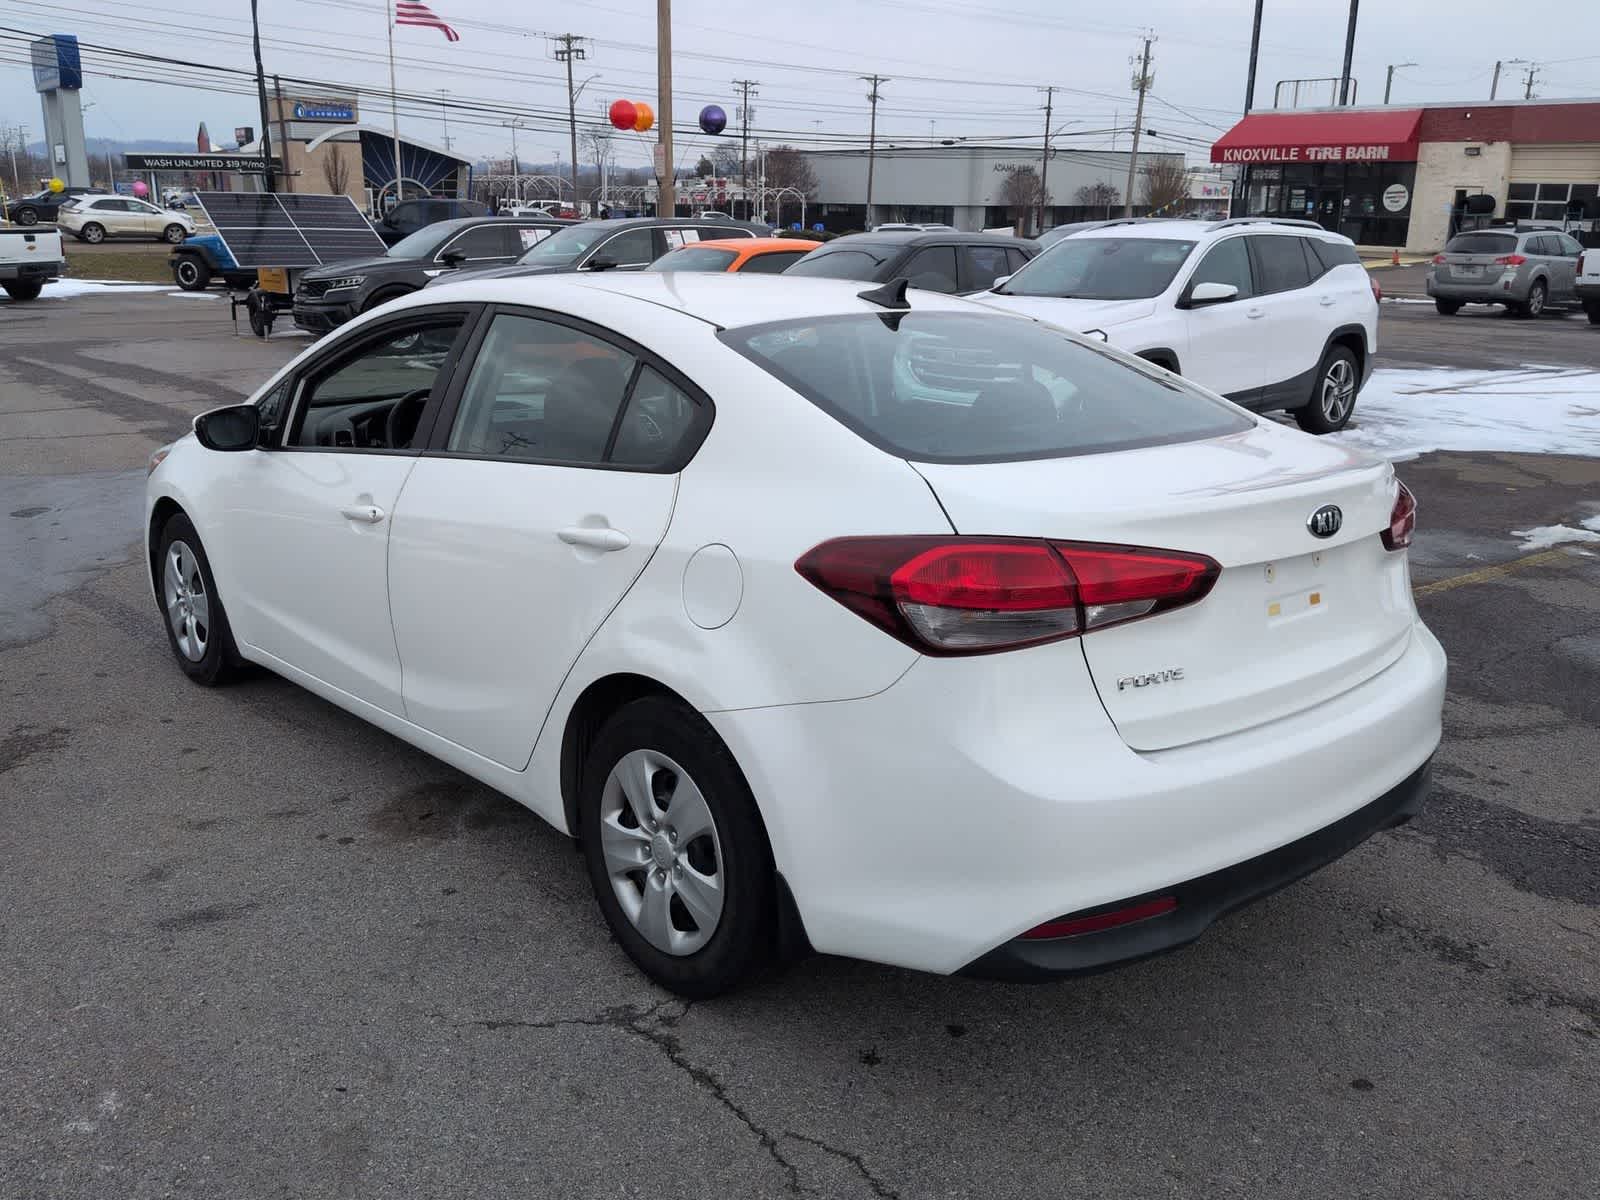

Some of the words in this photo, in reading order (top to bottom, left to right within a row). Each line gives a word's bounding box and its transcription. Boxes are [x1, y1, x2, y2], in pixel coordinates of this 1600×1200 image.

[1223, 147, 1299, 161] KNOXVILLE
[1345, 145, 1389, 160] BARN
[143, 159, 173, 167] WASH
[175, 159, 223, 168] UNLIMITED
[1117, 667, 1184, 691] FORTE
